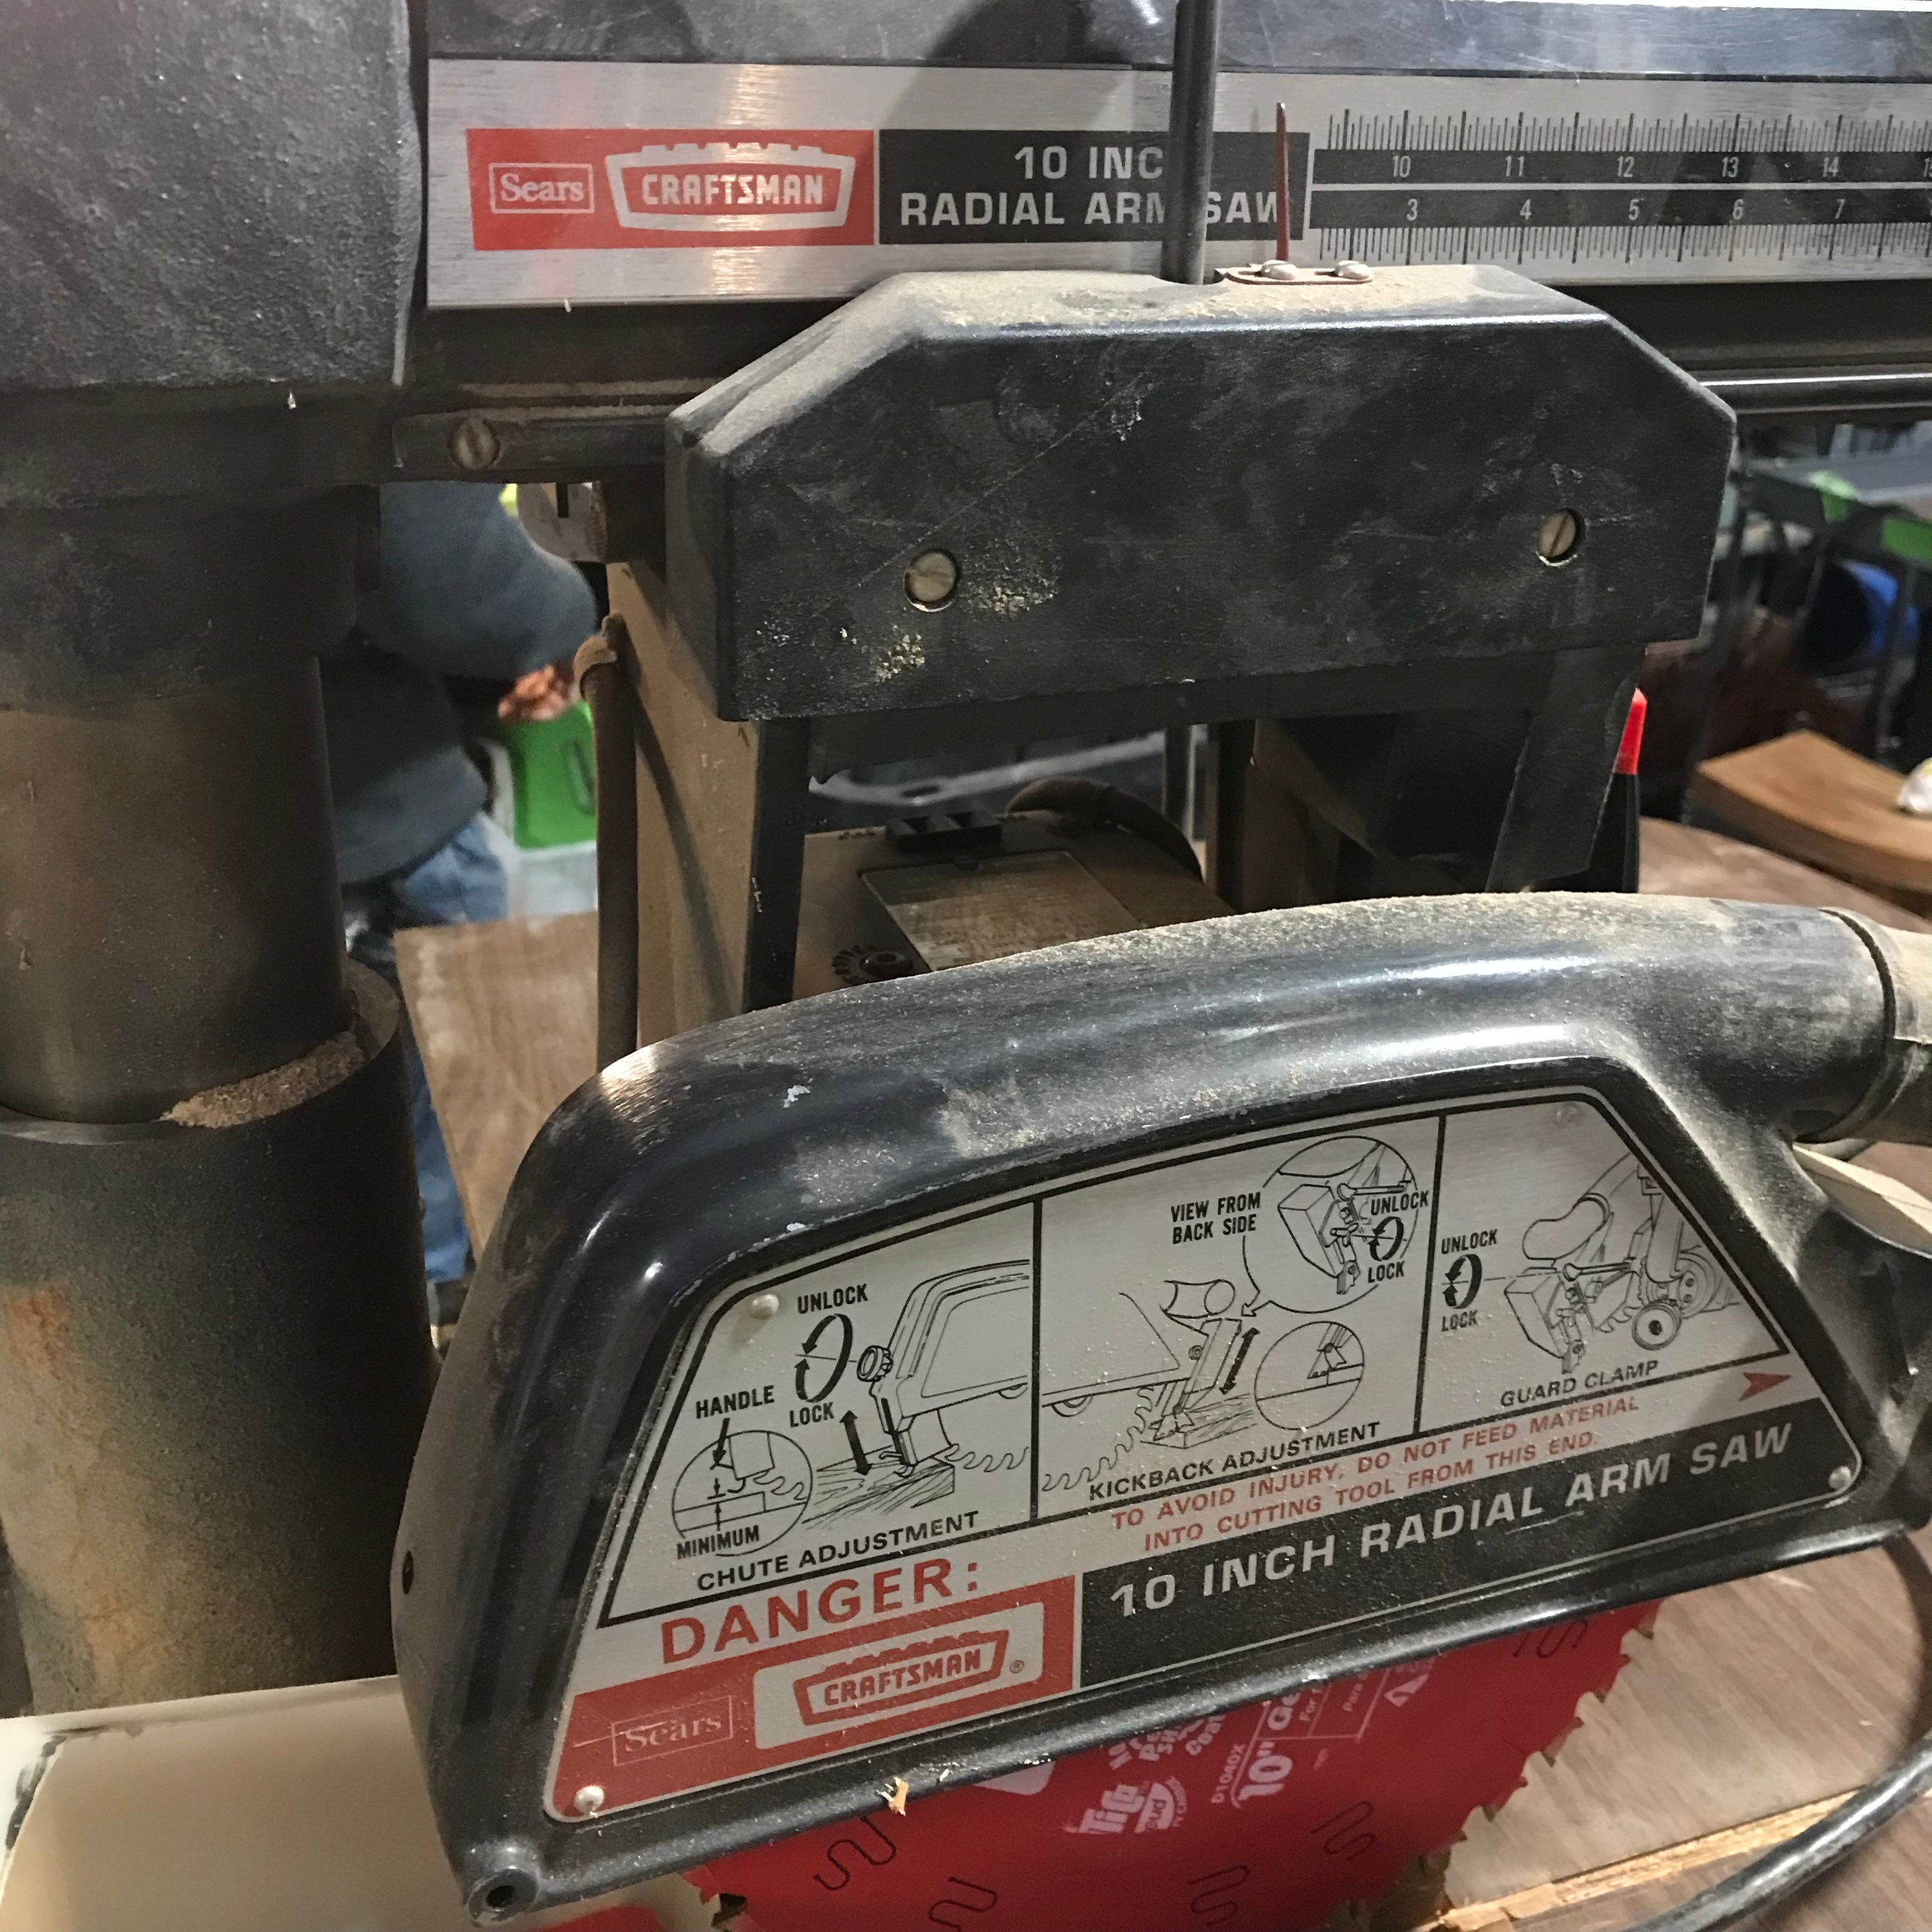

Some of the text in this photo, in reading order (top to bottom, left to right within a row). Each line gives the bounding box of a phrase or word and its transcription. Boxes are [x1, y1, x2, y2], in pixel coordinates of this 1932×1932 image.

[1015, 146, 1163, 179] 10 INC
[1392, 155, 1411, 178] 10
[1505, 155, 1525, 178] 11
[1617, 156, 1635, 178] 12
[1722, 157, 1740, 178] 13
[1822, 157, 1839, 178] 14
[500, 173, 585, 202] Sears
[641, 174, 824, 205] CRAFTSMAN
[901, 192, 1065, 226] RADIAL
[1407, 199, 1846, 222] 3 4 5 6 7
[1170, 1192, 1261, 1223] VIEW FROM
[1370, 1191, 1429, 1215] UNLOCK
[1172, 1214, 1257, 1245] BACK SIDE
[1441, 1229, 1498, 1255] UNLOCK
[1368, 1260, 1406, 1284] LOCK
[797, 1284, 869, 1314] UNLOCK
[1441, 1310, 1478, 1332] LOCK
[1500, 1360, 1659, 1407] GUARD CLAMP
[696, 1385, 775, 1420] HANDLE
[789, 1402, 834, 1428] LOCK
[1090, 1422, 1380, 1501] KICKBACK ADJUSTMENT
[1111, 1508, 1144, 1529] TO
[1157, 1487, 1235, 1520] AVOID
[1358, 1452, 1390, 1473] DO
[1404, 1438, 1451, 1464] NOT
[1463, 1423, 1516, 1448] FEED
[1529, 1395, 1639, 1434] MATERIAL
[1144, 1524, 1203, 1552] INTO
[1218, 1499, 1322, 1533] CUTTING
[1335, 1481, 1395, 1505] TOOL
[1408, 1460, 1473, 1489] FROM
[1486, 1444, 1536, 1470] THIS
[1110, 1423, 1792, 1617] 10 INCH RADIAL ARM SAW
[677, 1525, 760, 1560] MINIMUM
[697, 1510, 979, 1591] CHUTE ADJUSTMENT
[661, 1557, 979, 1664] DANGER:
[824, 1647, 982, 1706] CRAFTSMAN
[624, 1715, 722, 1753] Sears
